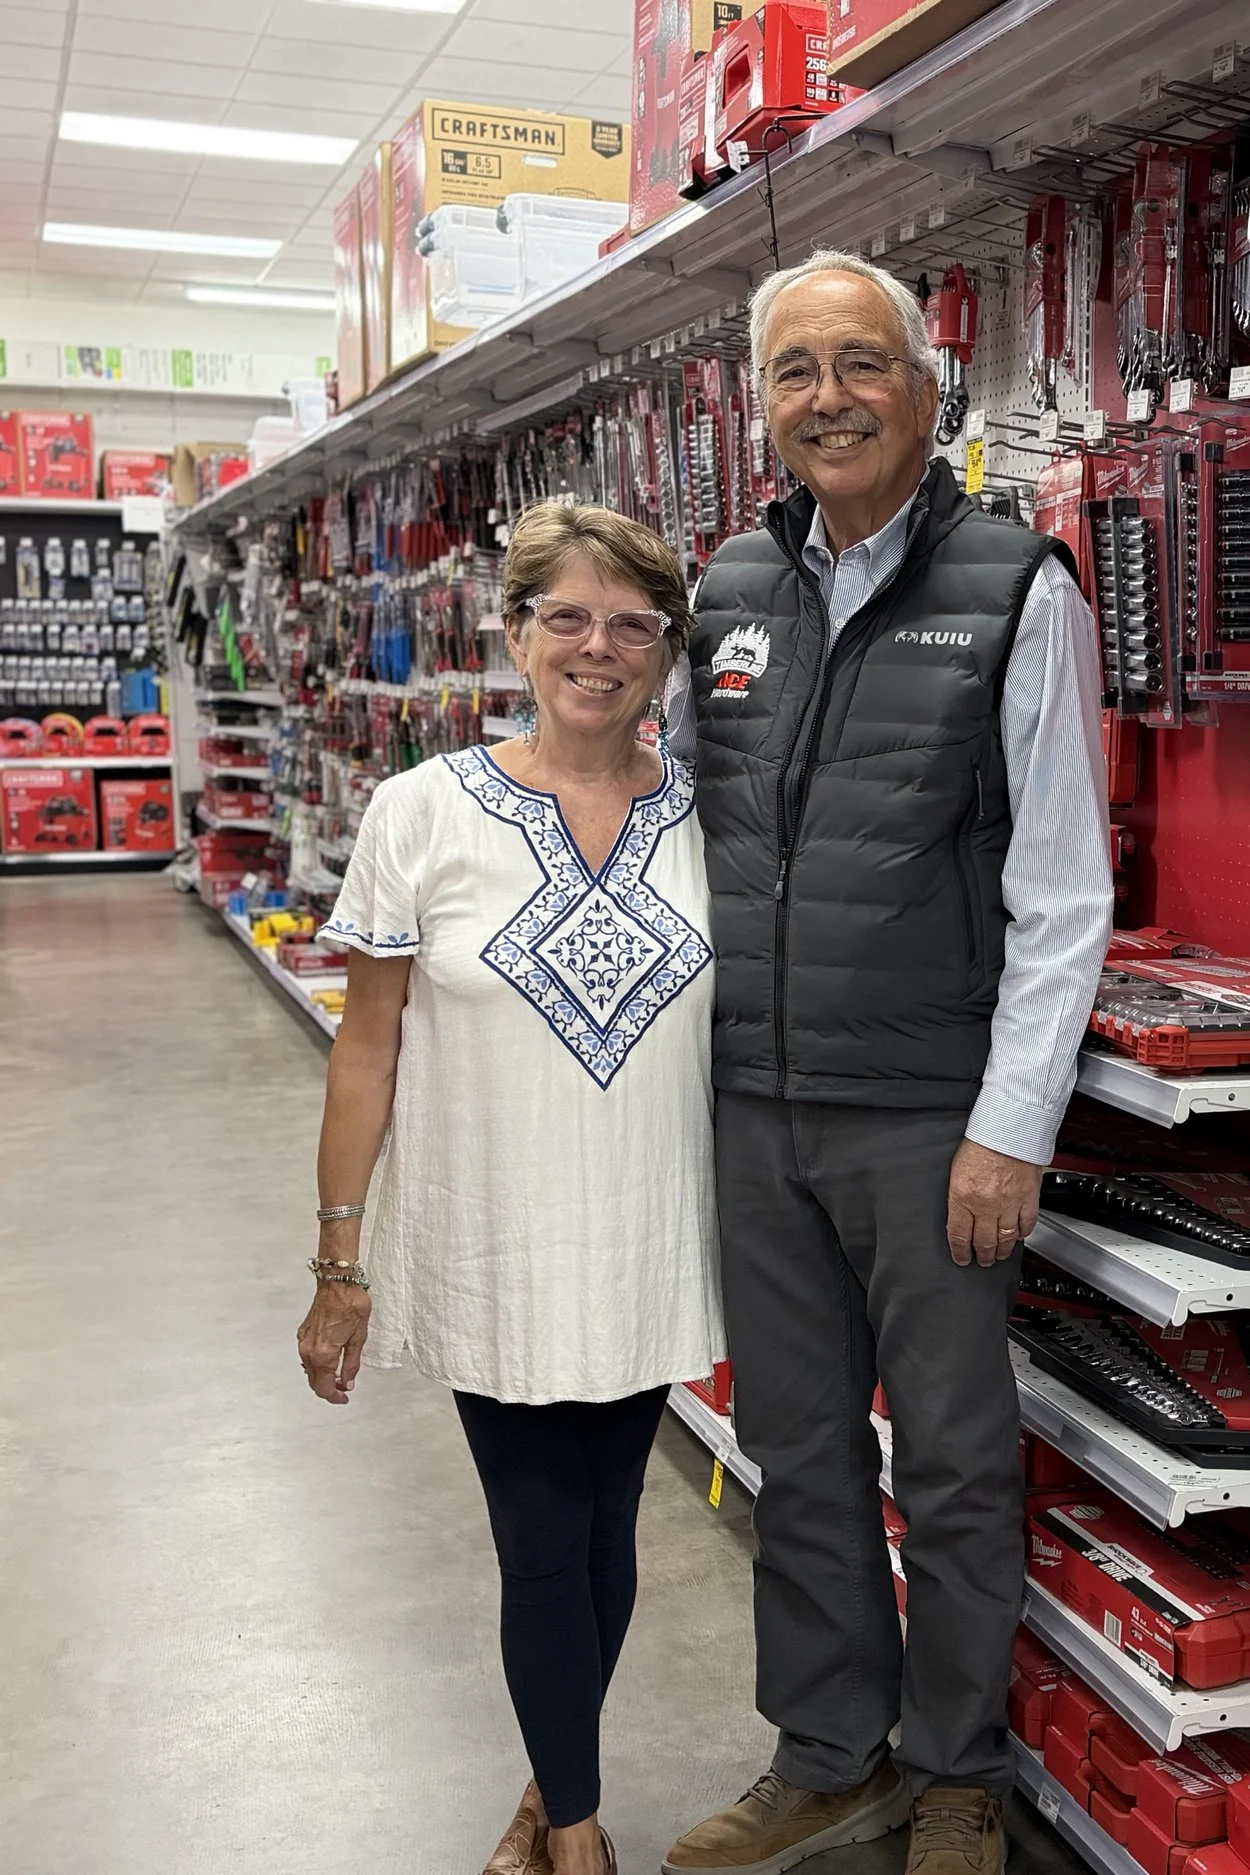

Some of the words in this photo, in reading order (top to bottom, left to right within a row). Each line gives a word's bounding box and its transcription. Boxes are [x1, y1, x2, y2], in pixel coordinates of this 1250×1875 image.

[717, 5, 728, 18] 10
[806, 56, 827, 71] 256
[441, 118, 557, 146] CRAFTSMAN
[476, 156, 491, 168] 6.5
[919, 631, 973, 646] KUIU
[714, 659, 766, 675] TIMBERLINE
[716, 673, 751, 690] ACE
[711, 688, 750, 699] Hardware
[1032, 1534, 1063, 1559] Milwaukee
[1099, 1562, 1133, 1582] DRIVE
